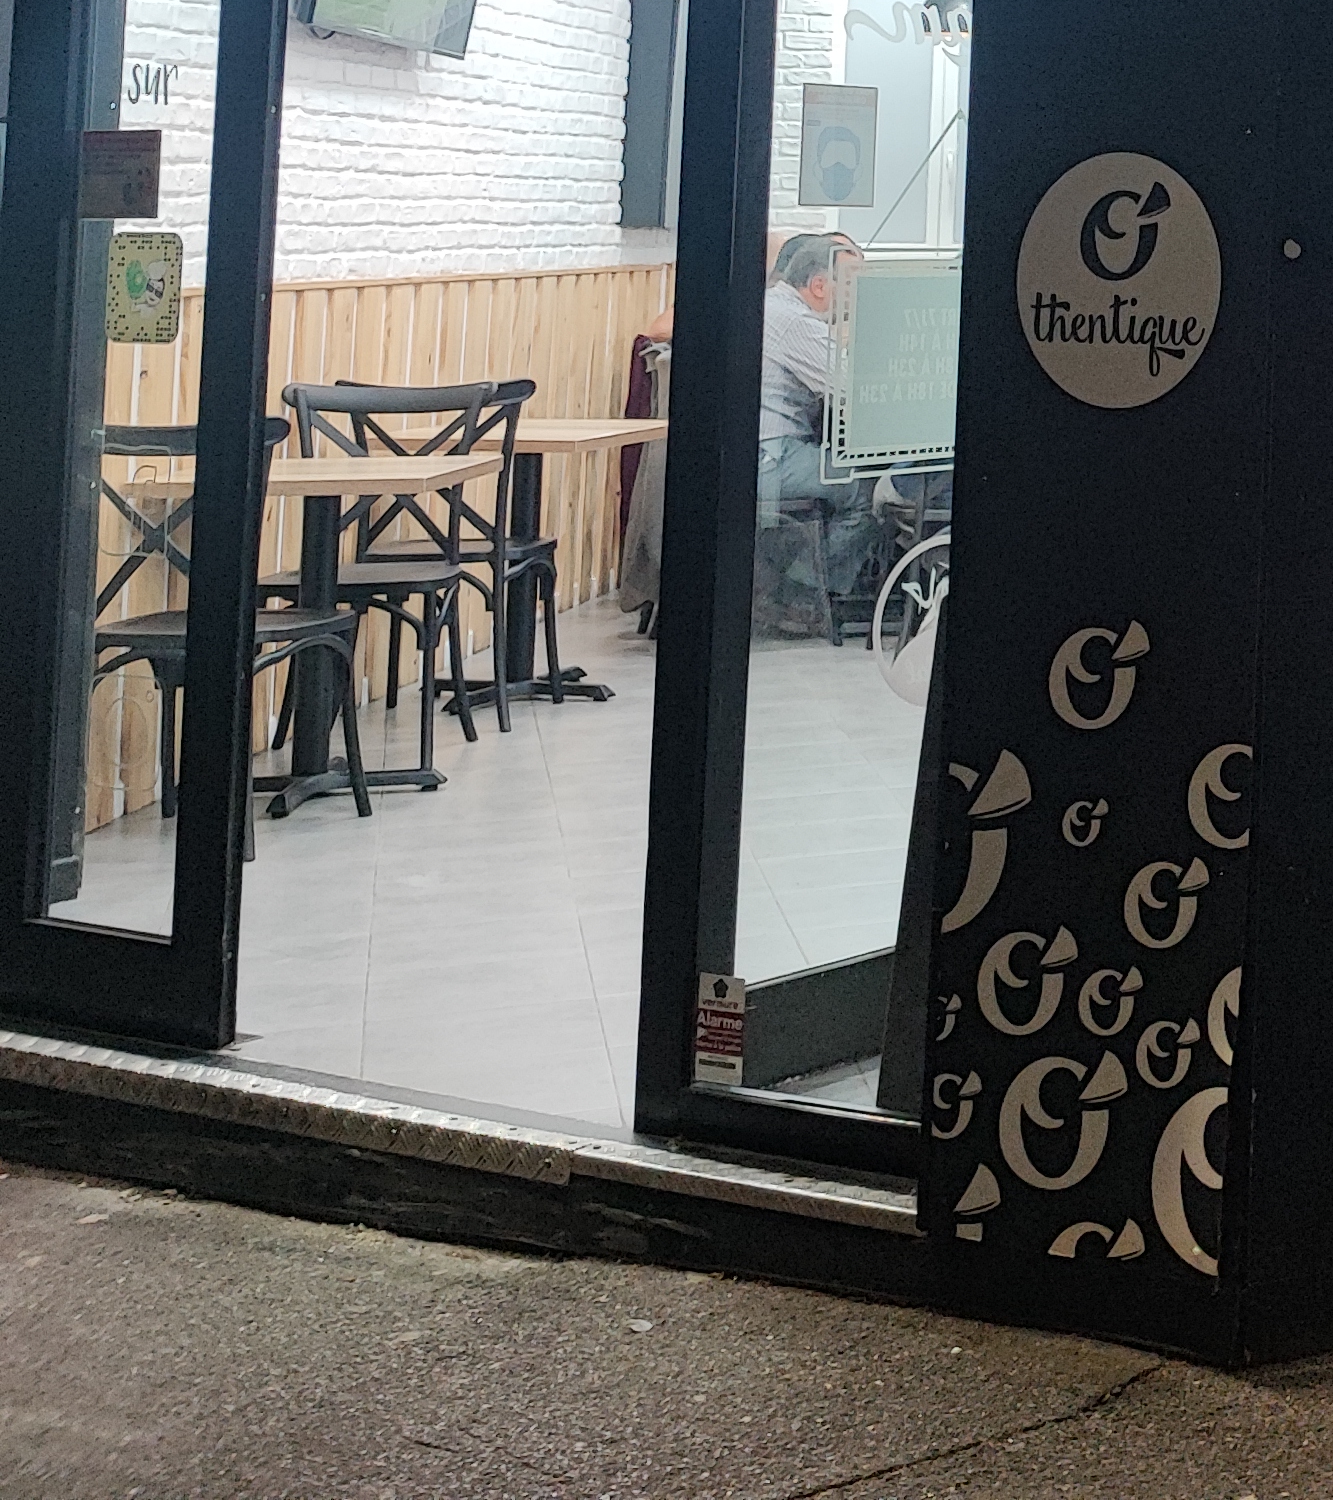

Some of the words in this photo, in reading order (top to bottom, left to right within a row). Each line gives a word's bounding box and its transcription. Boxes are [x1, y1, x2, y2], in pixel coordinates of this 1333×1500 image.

[127, 61, 179, 106] sur
[1031, 291, 1205, 377] thentique
[697, 1010, 743, 1030] Alarme
